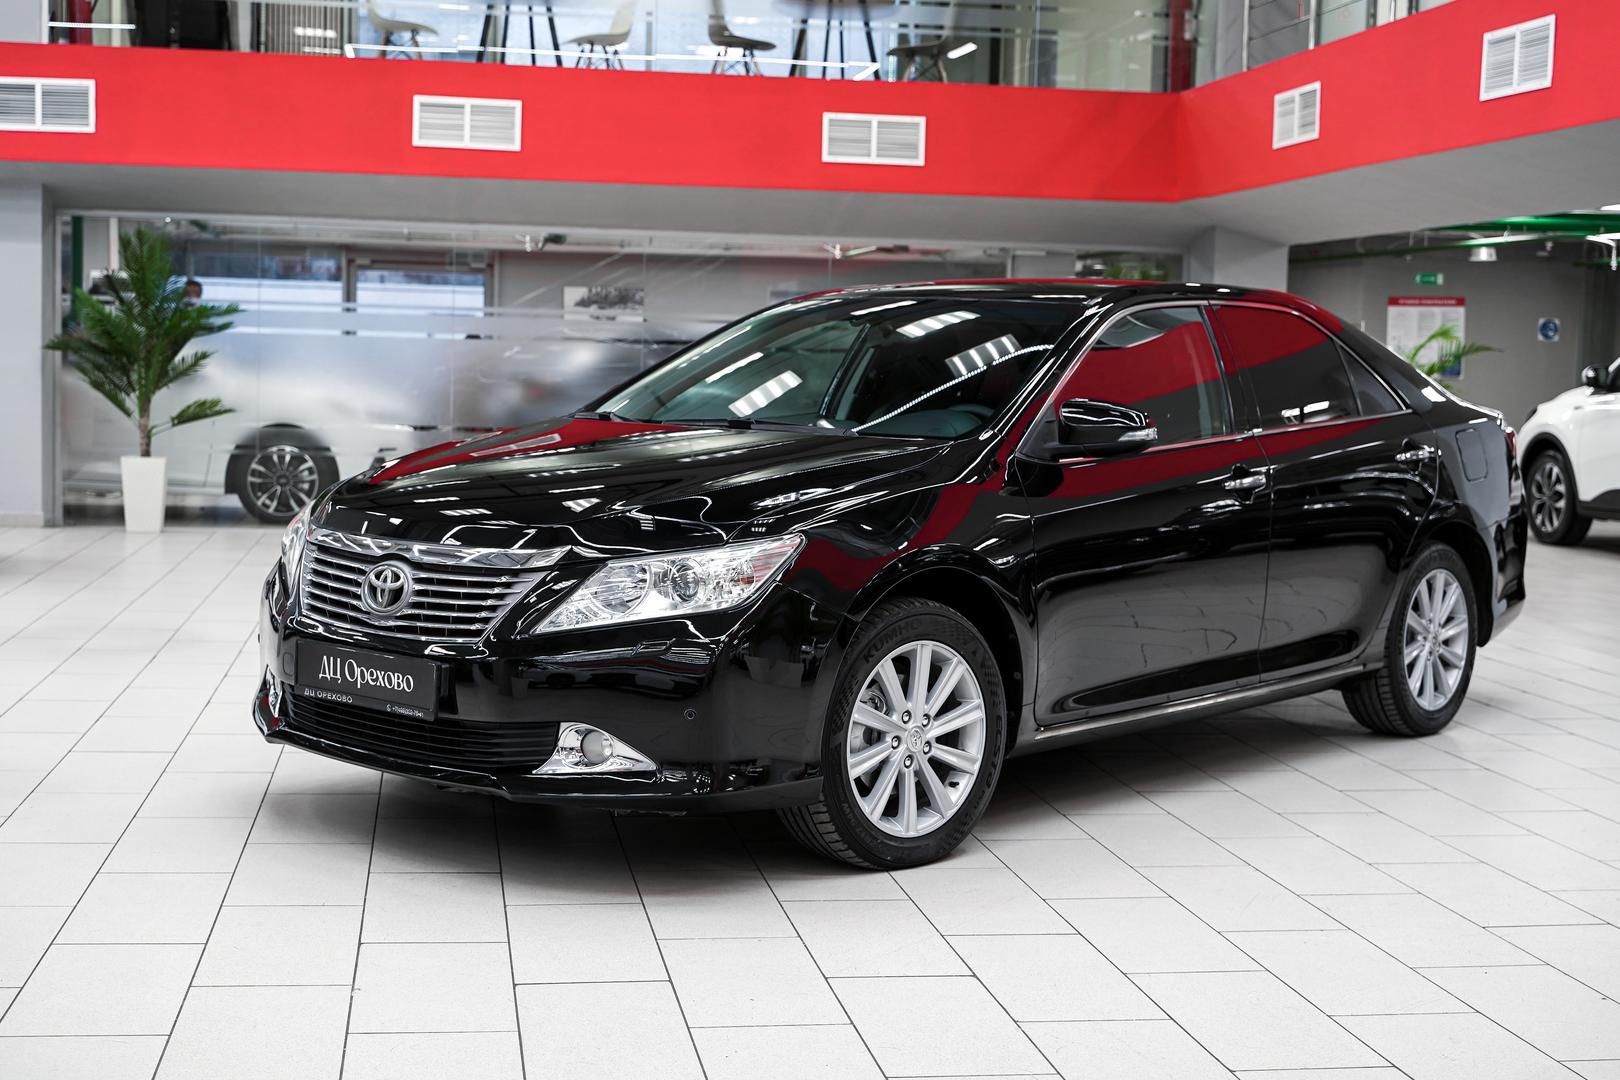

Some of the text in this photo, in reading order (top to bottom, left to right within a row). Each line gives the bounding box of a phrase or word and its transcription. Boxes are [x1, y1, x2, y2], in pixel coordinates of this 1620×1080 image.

[863, 618, 923, 664] KUMHO
[318, 655, 414, 693] ДЦ Орехово
[304, 688, 353, 703] ДЦ ОРЕХОВО
